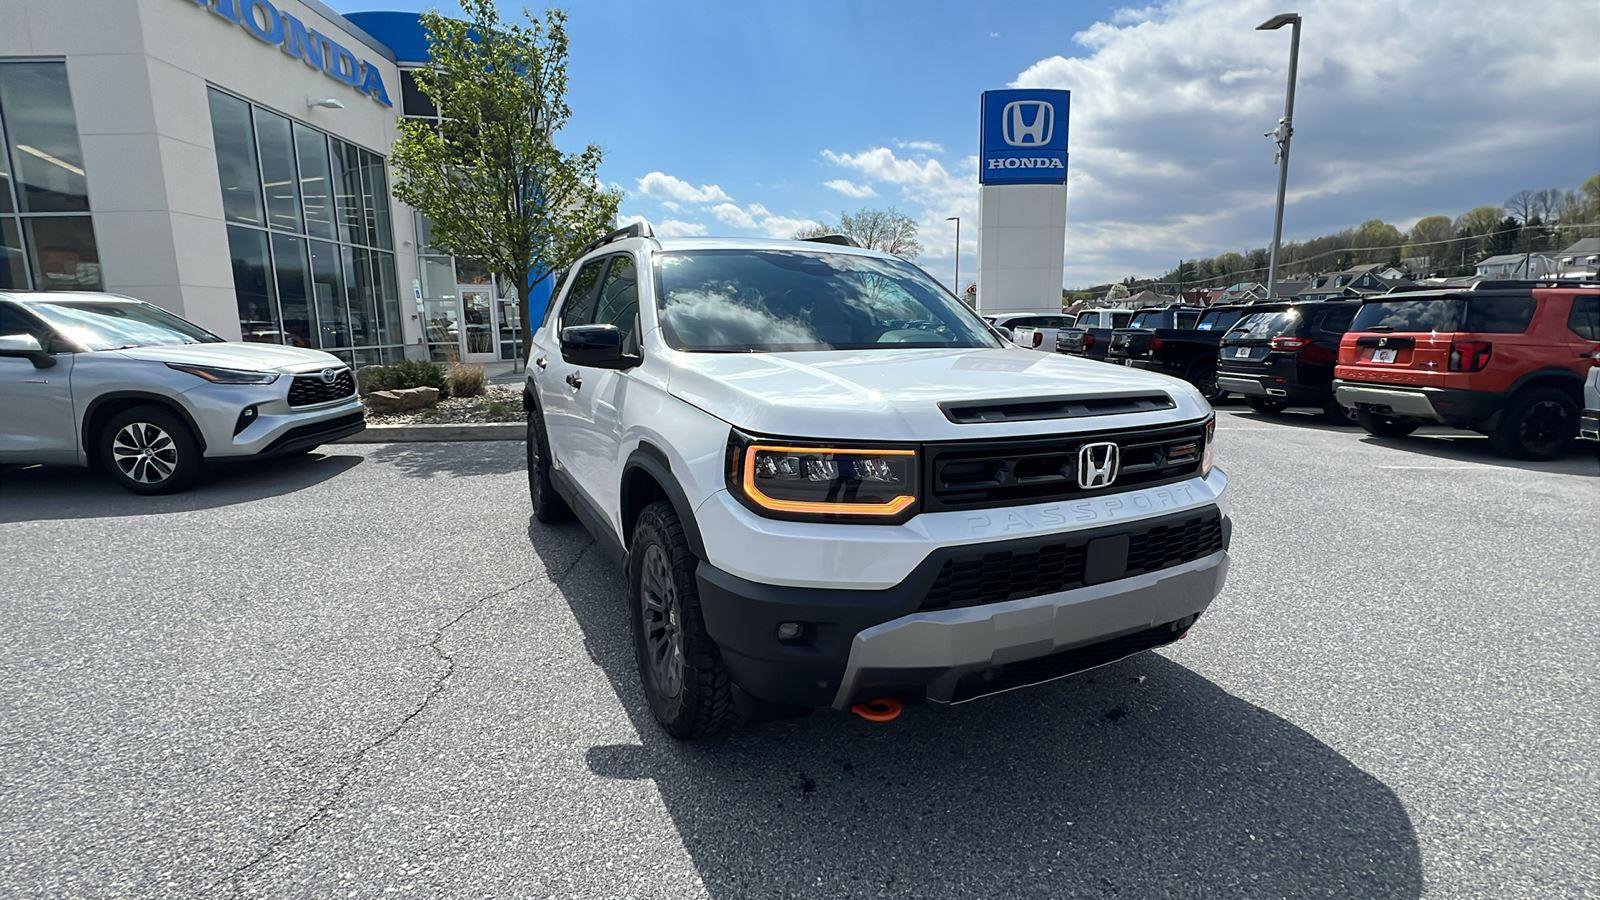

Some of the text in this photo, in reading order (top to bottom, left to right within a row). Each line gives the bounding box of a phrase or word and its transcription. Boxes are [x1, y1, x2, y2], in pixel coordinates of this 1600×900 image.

[190, 0, 392, 107] ONDA
[987, 157, 1065, 169] HONDA
[966, 484, 1196, 535] PASSPORT
